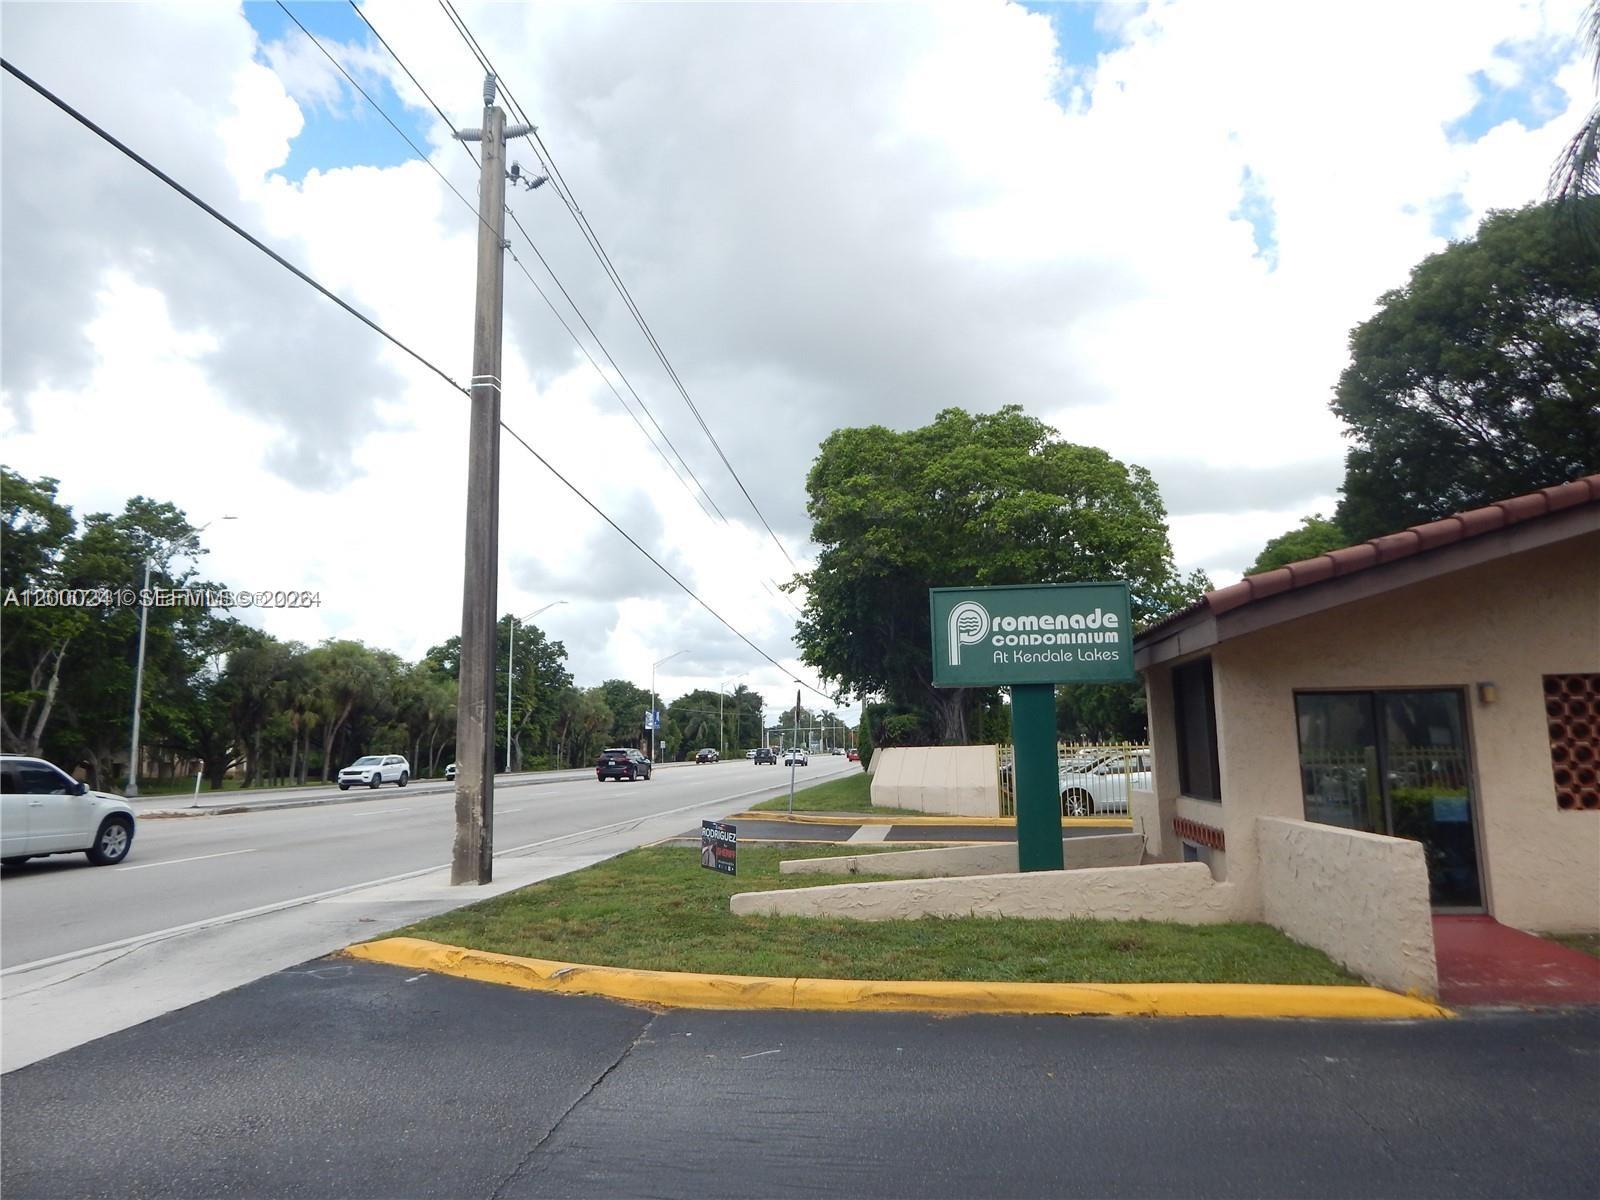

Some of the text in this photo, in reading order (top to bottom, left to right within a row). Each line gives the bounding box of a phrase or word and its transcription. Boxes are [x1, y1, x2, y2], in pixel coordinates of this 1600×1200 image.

[948, 601, 1119, 665] Promenade
[993, 648, 1120, 664] At Kendale Lakes
[702, 827, 737, 843] RODRIGUEZ
